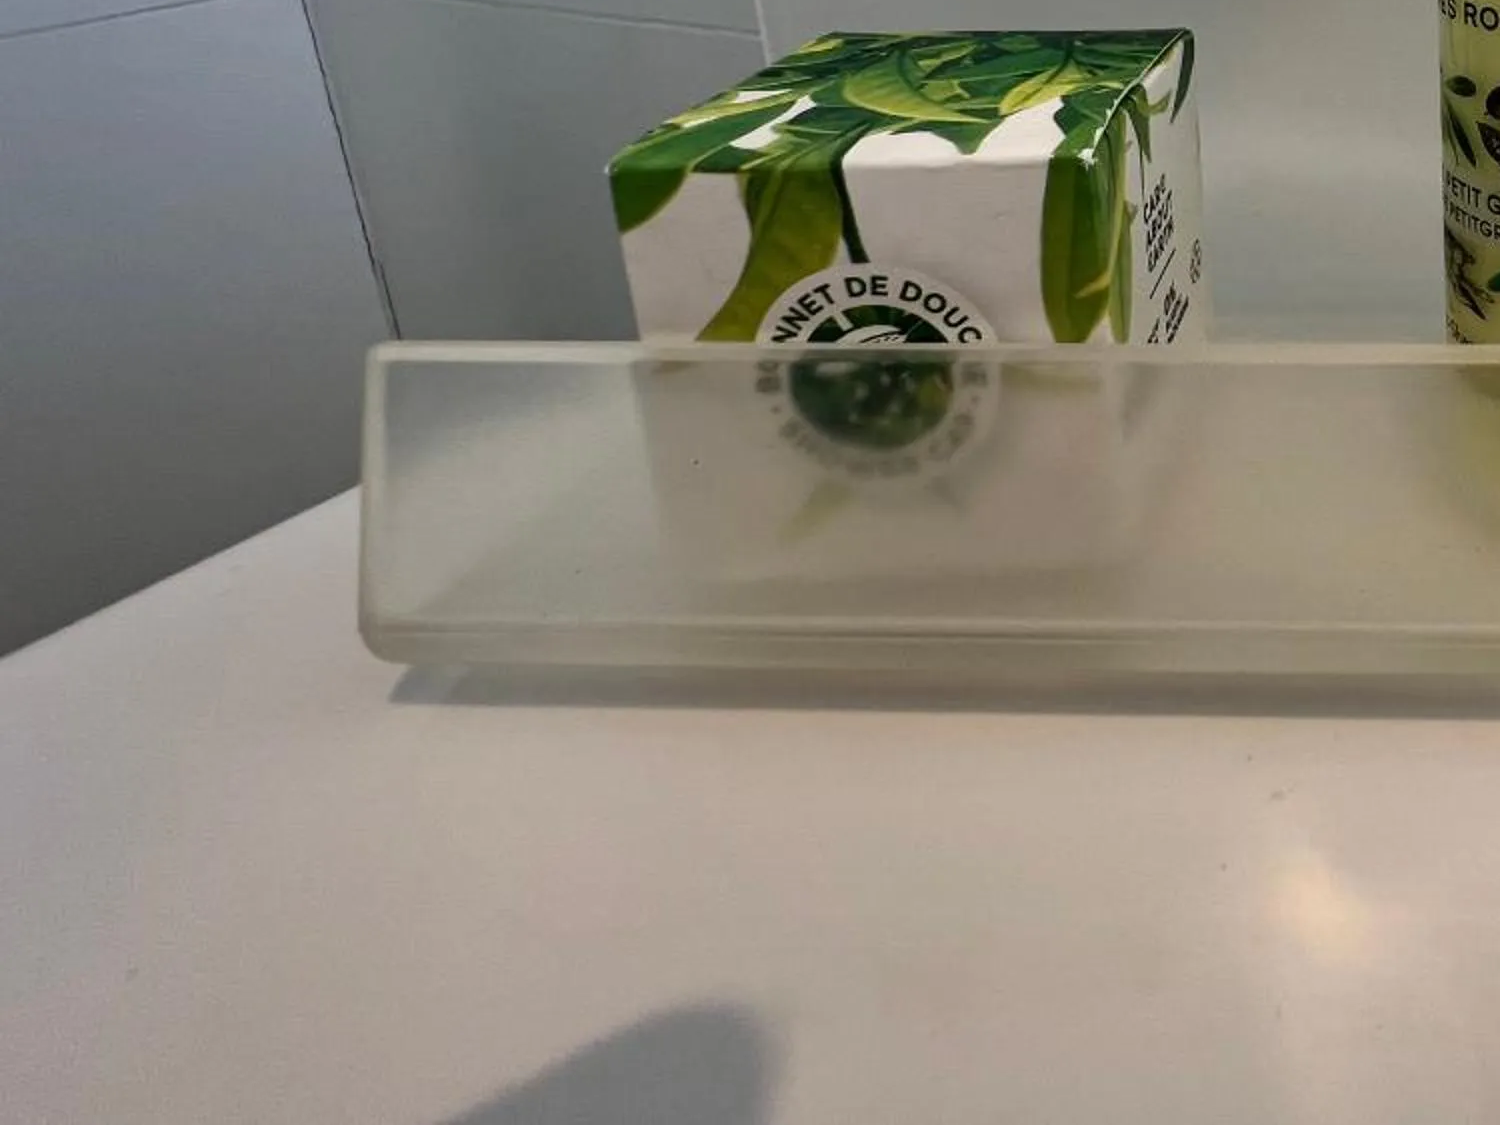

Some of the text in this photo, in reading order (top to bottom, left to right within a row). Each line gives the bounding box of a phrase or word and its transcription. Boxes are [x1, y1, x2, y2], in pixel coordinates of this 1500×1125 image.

[771, 275, 983, 344] NNET DE DOUC
